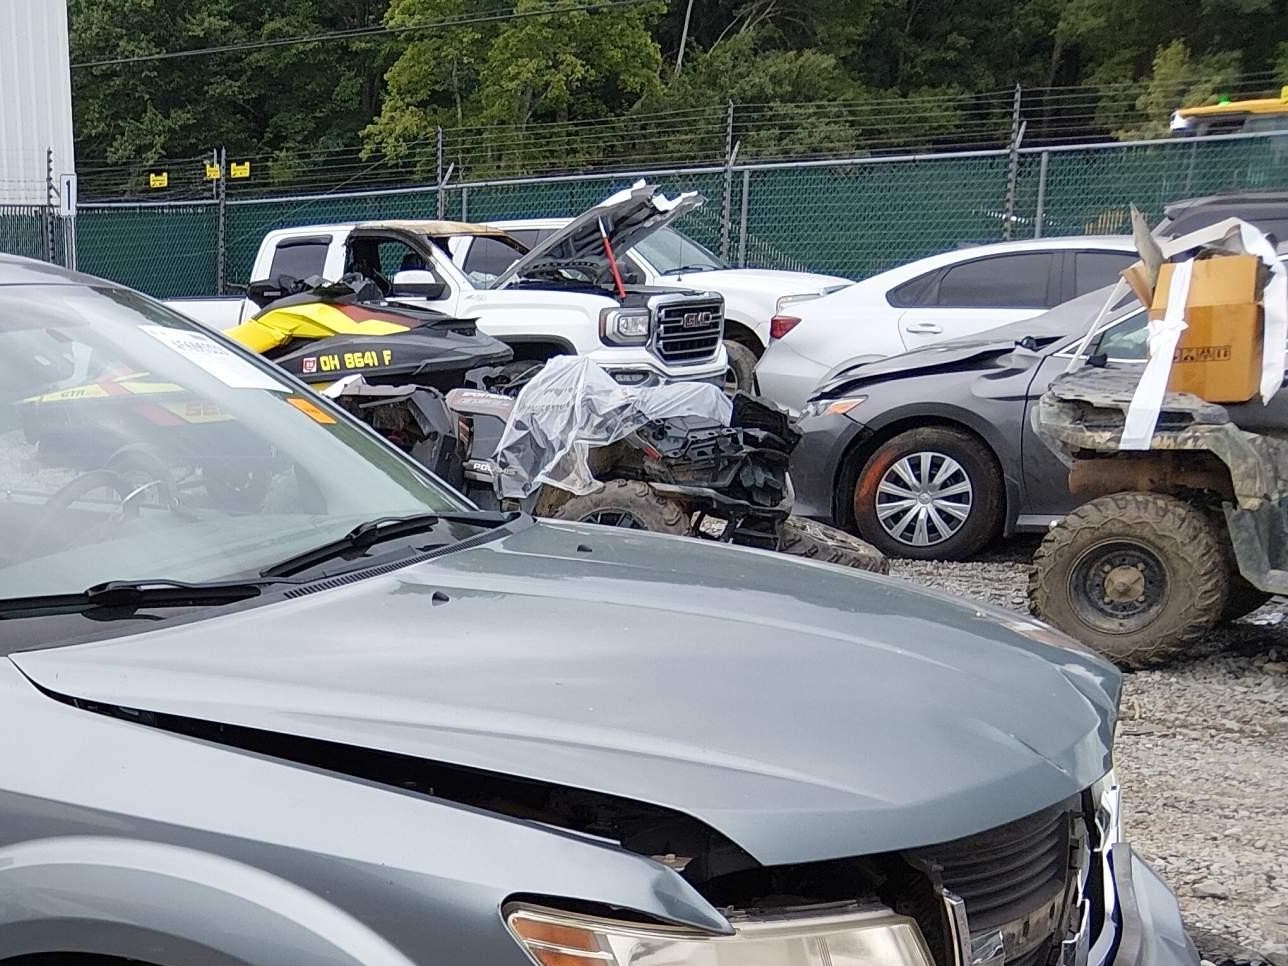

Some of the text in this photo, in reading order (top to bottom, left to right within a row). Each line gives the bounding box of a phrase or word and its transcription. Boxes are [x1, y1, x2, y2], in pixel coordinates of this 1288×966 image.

[66, 179, 71, 211] 1
[683, 311, 713, 328] GMC
[320, 355, 340, 371] OH
[344, 351, 379, 369] 8641
